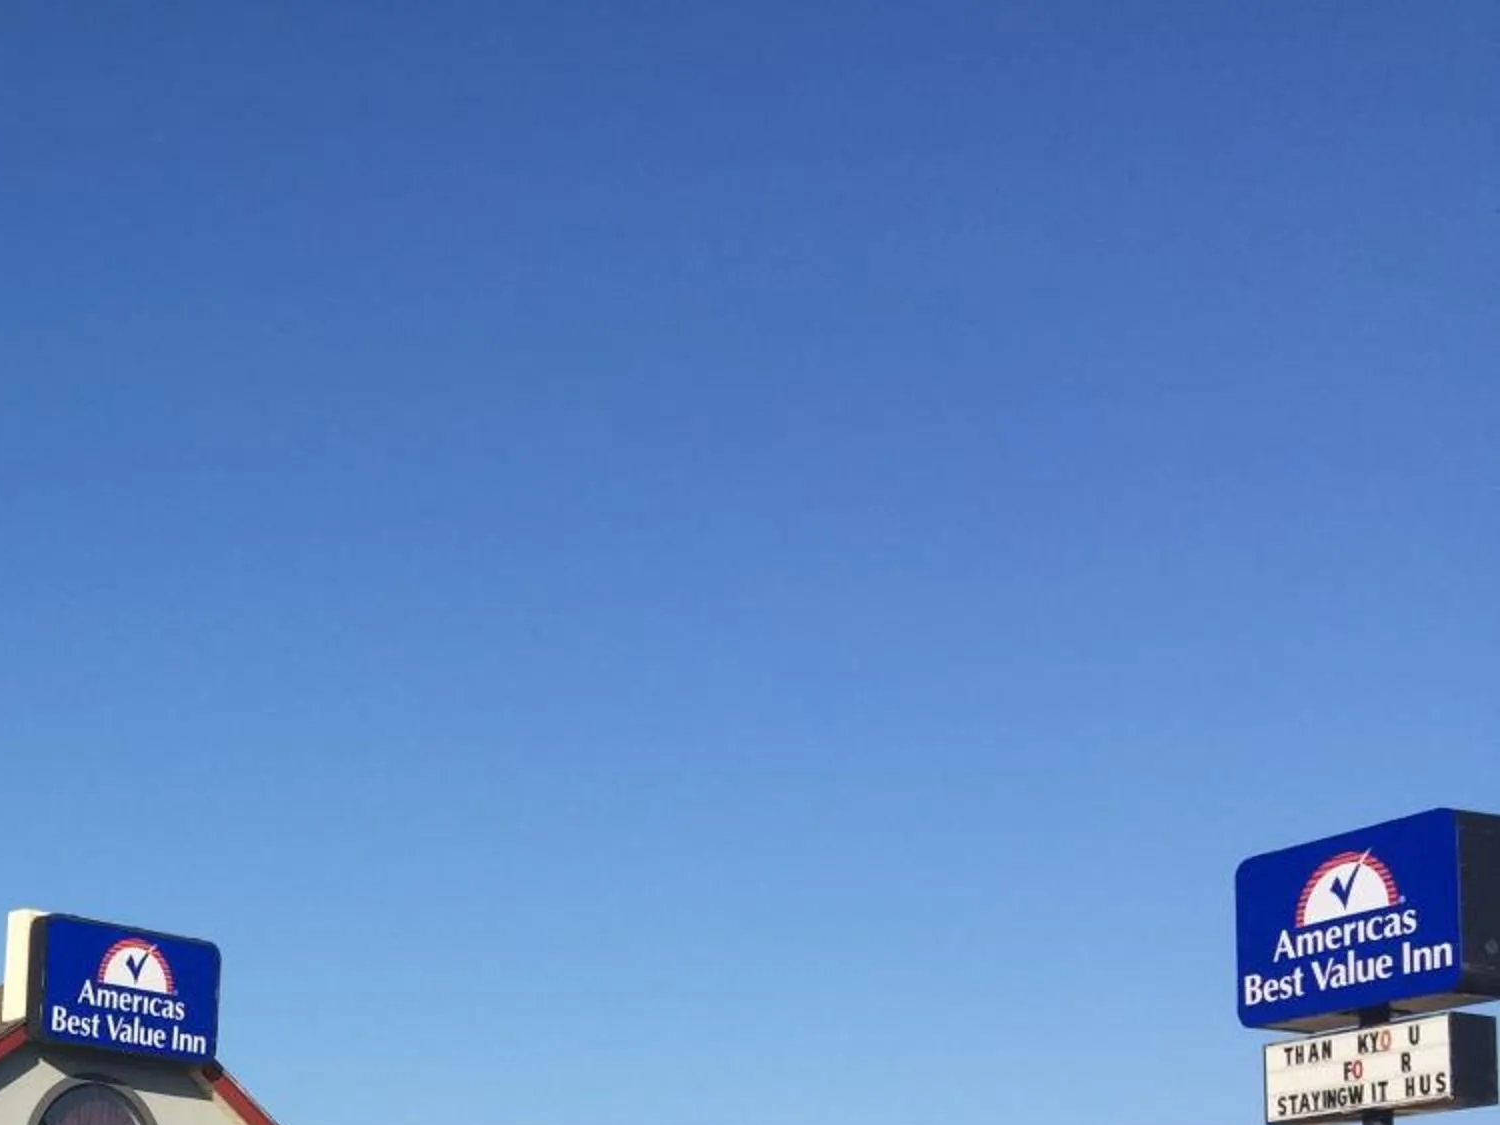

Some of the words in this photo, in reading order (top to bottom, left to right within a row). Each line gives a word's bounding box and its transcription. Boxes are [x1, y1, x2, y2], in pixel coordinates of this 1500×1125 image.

[1274, 908, 1417, 962] Americas
[1244, 970, 1305, 1006] Best
[1311, 949, 1393, 991] Value
[1403, 940, 1453, 975] Inn
[78, 979, 185, 1021] Americas
[51, 1005, 99, 1038] Best
[107, 1014, 167, 1048] Value
[172, 1026, 206, 1055] Inn
